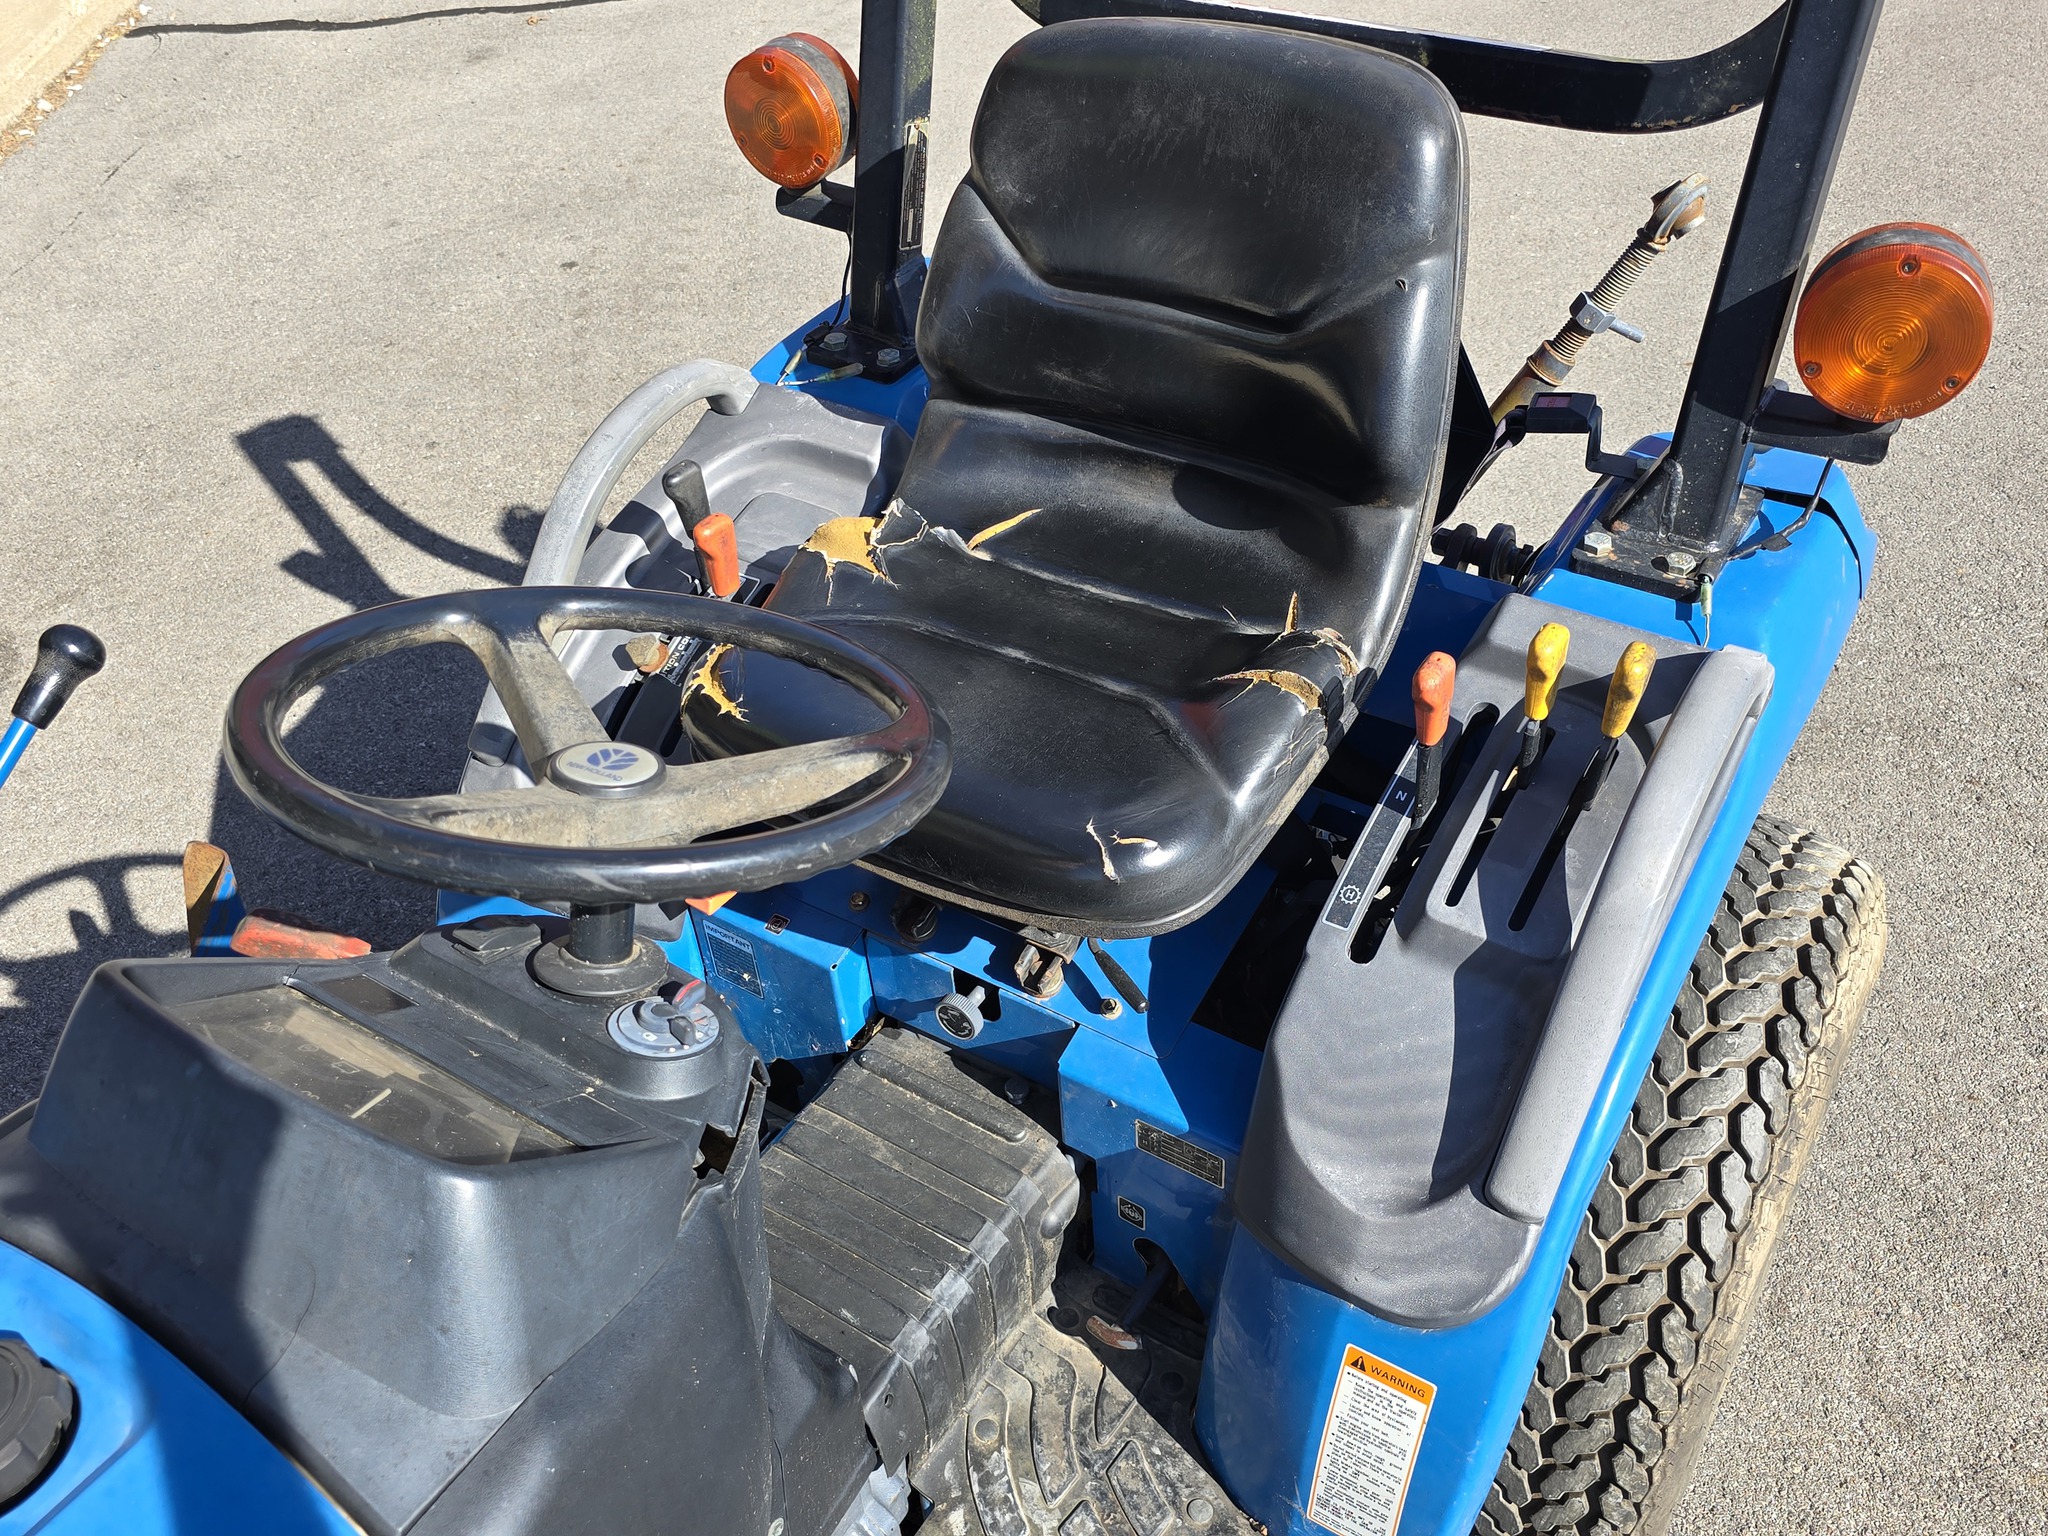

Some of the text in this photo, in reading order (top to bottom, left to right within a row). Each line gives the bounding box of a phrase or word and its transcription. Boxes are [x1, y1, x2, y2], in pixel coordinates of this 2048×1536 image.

[585, 768, 623, 782] HOLLAND
[1395, 790, 1407, 801] N
[705, 924, 751, 949] IMPORTANT
[1371, 1365, 1425, 1398] WARNING
